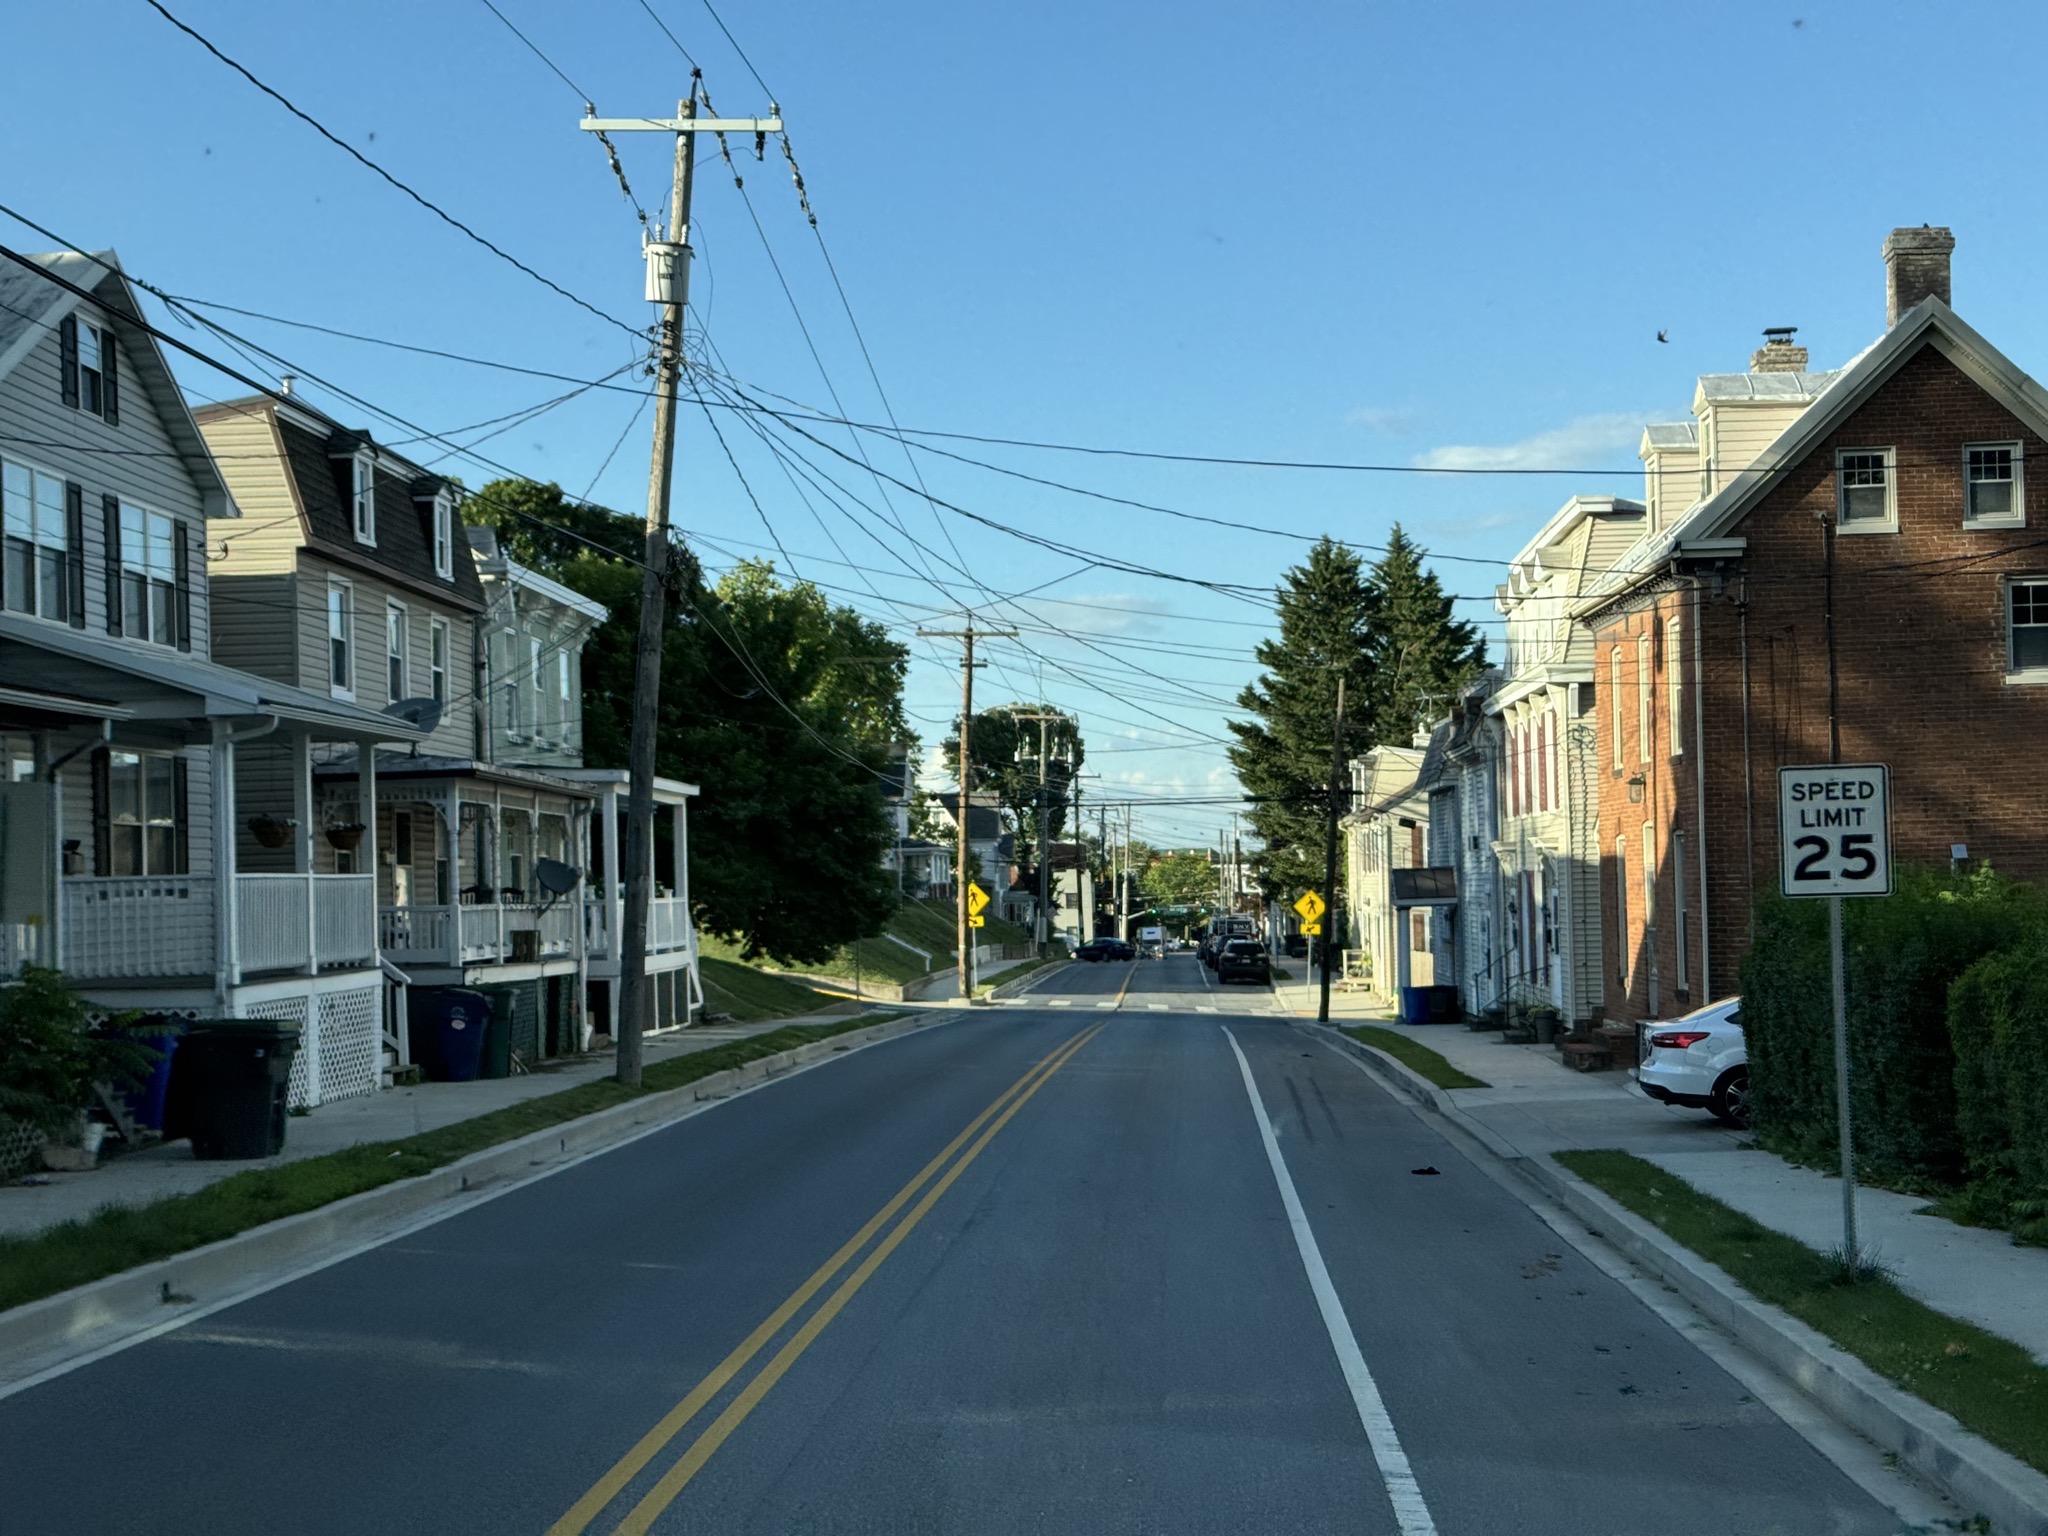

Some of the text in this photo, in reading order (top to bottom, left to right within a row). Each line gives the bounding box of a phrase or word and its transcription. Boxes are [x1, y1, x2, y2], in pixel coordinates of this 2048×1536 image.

[1791, 781, 1875, 801] SPEED
[1801, 808, 1865, 828] LIMIT
[1793, 834, 1876, 881] 25
